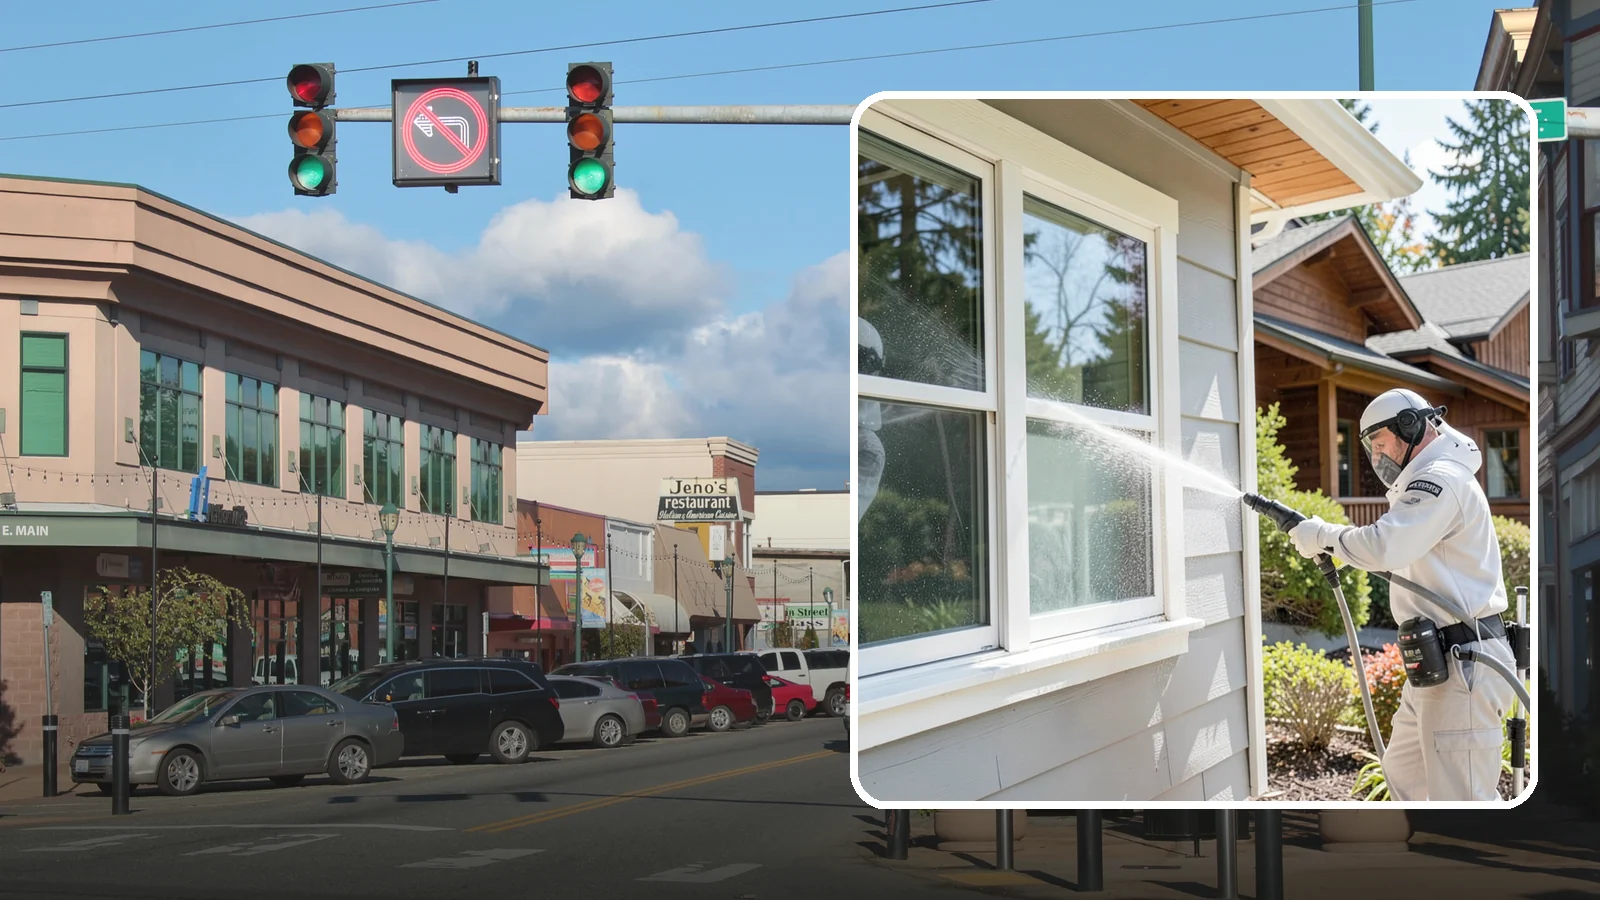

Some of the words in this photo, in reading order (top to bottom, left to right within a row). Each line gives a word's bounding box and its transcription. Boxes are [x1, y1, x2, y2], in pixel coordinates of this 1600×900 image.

[669, 480, 728, 494] Jeno's
[665, 496, 731, 509] restaurant
[658, 510, 682, 519] Italian
[686, 509, 715, 519] American
[715, 509, 737, 519] Cuisine
[2, 525, 13, 536] E.
[15, 525, 49, 536] MAIN
[797, 607, 828, 617] Street
